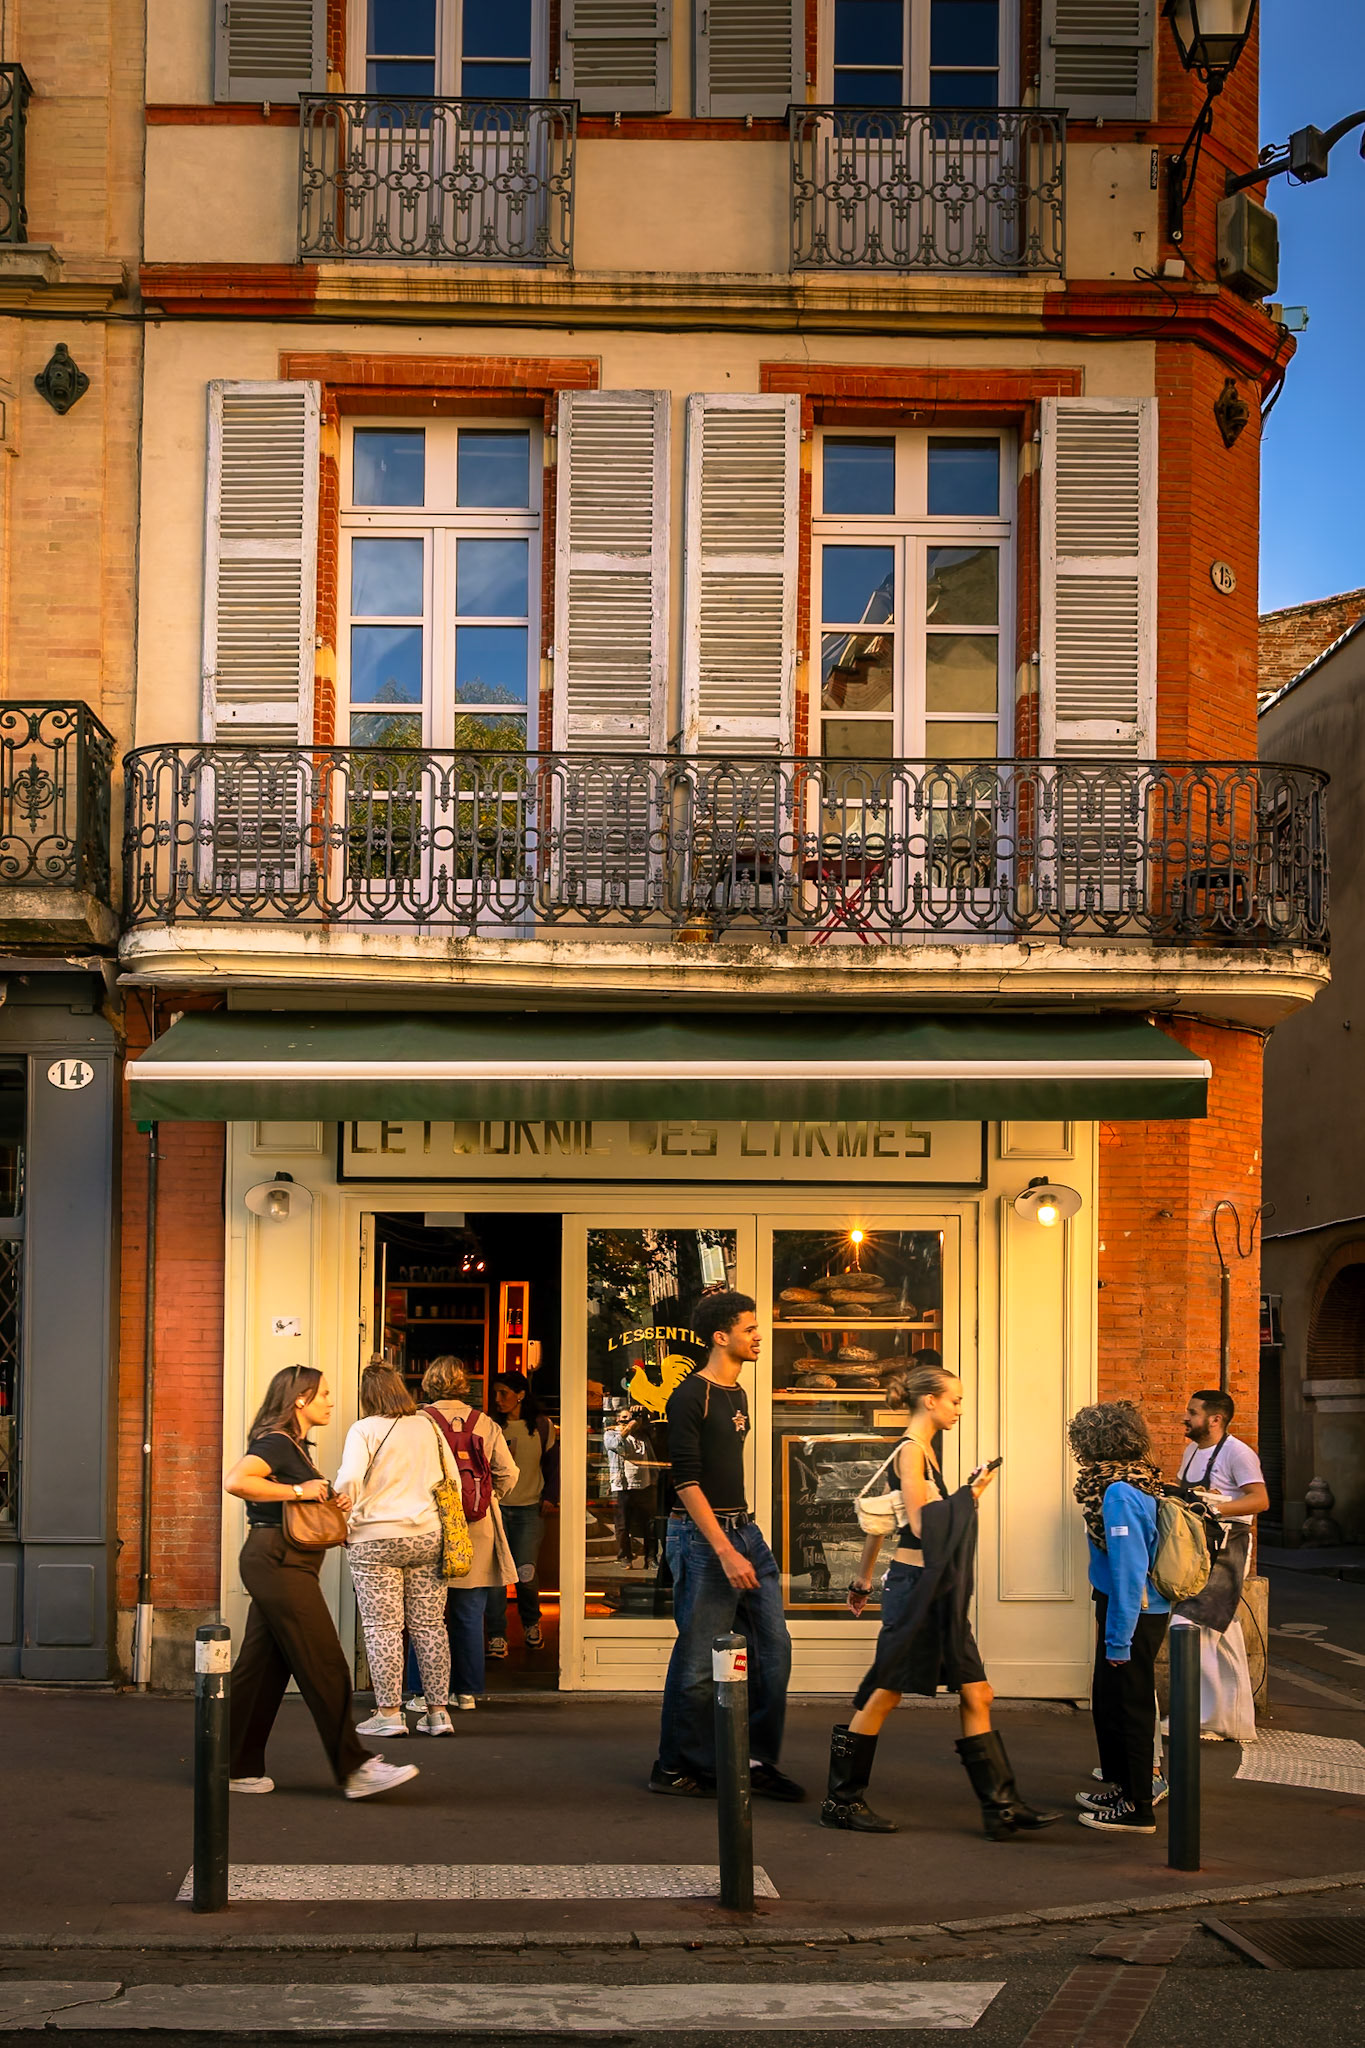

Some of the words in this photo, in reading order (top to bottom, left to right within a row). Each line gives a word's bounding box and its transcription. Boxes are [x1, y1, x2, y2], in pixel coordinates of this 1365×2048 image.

[1219, 566, 1232, 588] 15
[57, 1062, 84, 1085] 14
[608, 1326, 706, 1352] L'ESSENTIE
